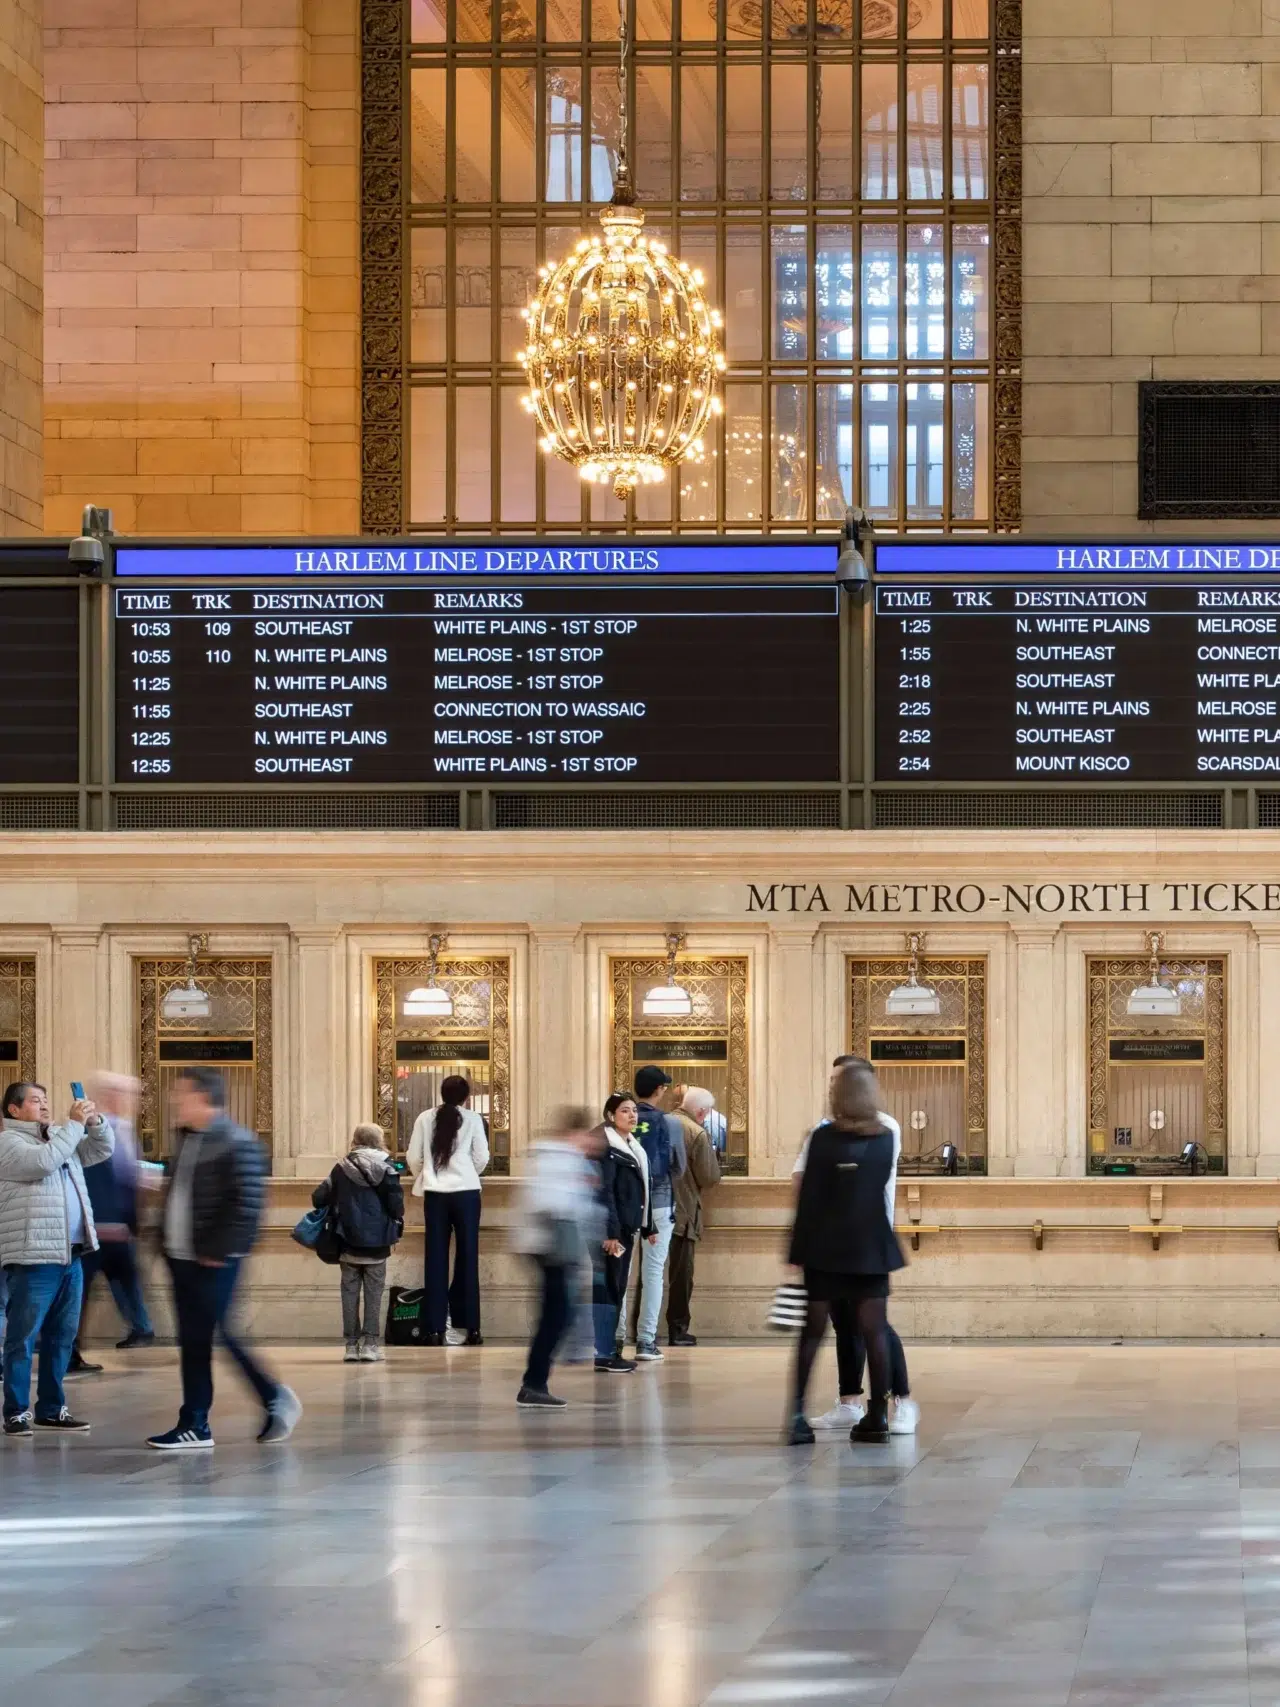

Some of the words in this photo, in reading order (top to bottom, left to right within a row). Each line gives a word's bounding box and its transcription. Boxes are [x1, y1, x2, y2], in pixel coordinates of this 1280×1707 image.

[295, 552, 406, 571] HARLEM
[414, 552, 477, 570] LINE
[485, 551, 658, 570] DEPARTURES
[1057, 549, 1170, 568] HARLEM
[1177, 550, 1241, 568] LINE
[123, 595, 170, 609] TIME
[192, 595, 231, 609] TRK
[253, 594, 383, 608] DESTINATION
[434, 594, 523, 608] REMARKS
[883, 592, 931, 606] TIME
[953, 592, 992, 606] TRK
[1015, 592, 1146, 606] DESTINATION
[132, 623, 170, 636] 10:53
[205, 623, 230, 635] 109
[255, 621, 353, 635] SOUTHEAST
[434, 621, 485, 634] WHITE
[491, 621, 546, 634] PLAINS
[561, 621, 590, 634] 1ST
[594, 620, 637, 634] STOP
[901, 620, 930, 633] 1:25
[1017, 619, 1031, 632] N.
[1036, 619, 1088, 632] WHITE
[1094, 619, 1150, 633] PLAINS
[1198, 619, 1276, 633] MELROSE
[132, 650, 170, 663] 10:55
[206, 650, 230, 663] 110
[255, 649, 270, 662] N.
[275, 649, 326, 662] WHITE
[331, 649, 387, 662] PLAINS
[435, 648, 512, 661] MELROSE
[527, 648, 556, 661] 1ST
[560, 648, 603, 661] STOP
[901, 647, 930, 660] 1:55
[1017, 646, 1115, 660] SOUTHEAST
[133, 678, 170, 690] 11:25
[255, 677, 270, 689] N.
[275, 676, 326, 689] WHITE
[331, 676, 387, 690] PLAINS
[435, 675, 512, 689] MELROSE
[527, 676, 556, 689] 1ST
[560, 675, 603, 689] STOP
[900, 675, 930, 688] 2:18
[1016, 674, 1115, 688] SOUTHEAST
[1197, 674, 1249, 687] WHITE
[133, 705, 170, 718] 11:55
[255, 704, 353, 717] SOUTHEAST
[434, 703, 541, 716] CONNECTION
[546, 703, 568, 716] TO
[572, 703, 645, 716] WASSAIC
[899, 702, 930, 715] 2:25
[1017, 702, 1031, 714] N.
[1036, 702, 1088, 715] WHITE
[1093, 702, 1149, 715] PLAINS
[1198, 701, 1276, 715] MELROSE
[132, 732, 170, 745] 12:25
[255, 731, 270, 744] N.
[275, 731, 326, 744] WHITE
[331, 731, 387, 744] PLAINS
[435, 730, 512, 744] MELROSE
[527, 731, 556, 744] 1ST
[560, 730, 603, 744] STOP
[899, 730, 930, 743] 2:52
[1016, 729, 1115, 743] SOUTHEAST
[1197, 729, 1249, 742] WHITE
[132, 760, 170, 773] 12:55
[255, 758, 353, 772] SOUTHEAST
[434, 758, 485, 771] WHITE
[491, 758, 546, 771] PLAINS
[561, 758, 590, 771] 1ST
[594, 758, 637, 771] STOP
[899, 757, 930, 770] 2:54
[1017, 756, 1075, 770] MOUNT
[1080, 757, 1129, 770] KISCO
[746, 884, 831, 911] MTA
[844, 884, 1149, 911] METRO-NORTH
